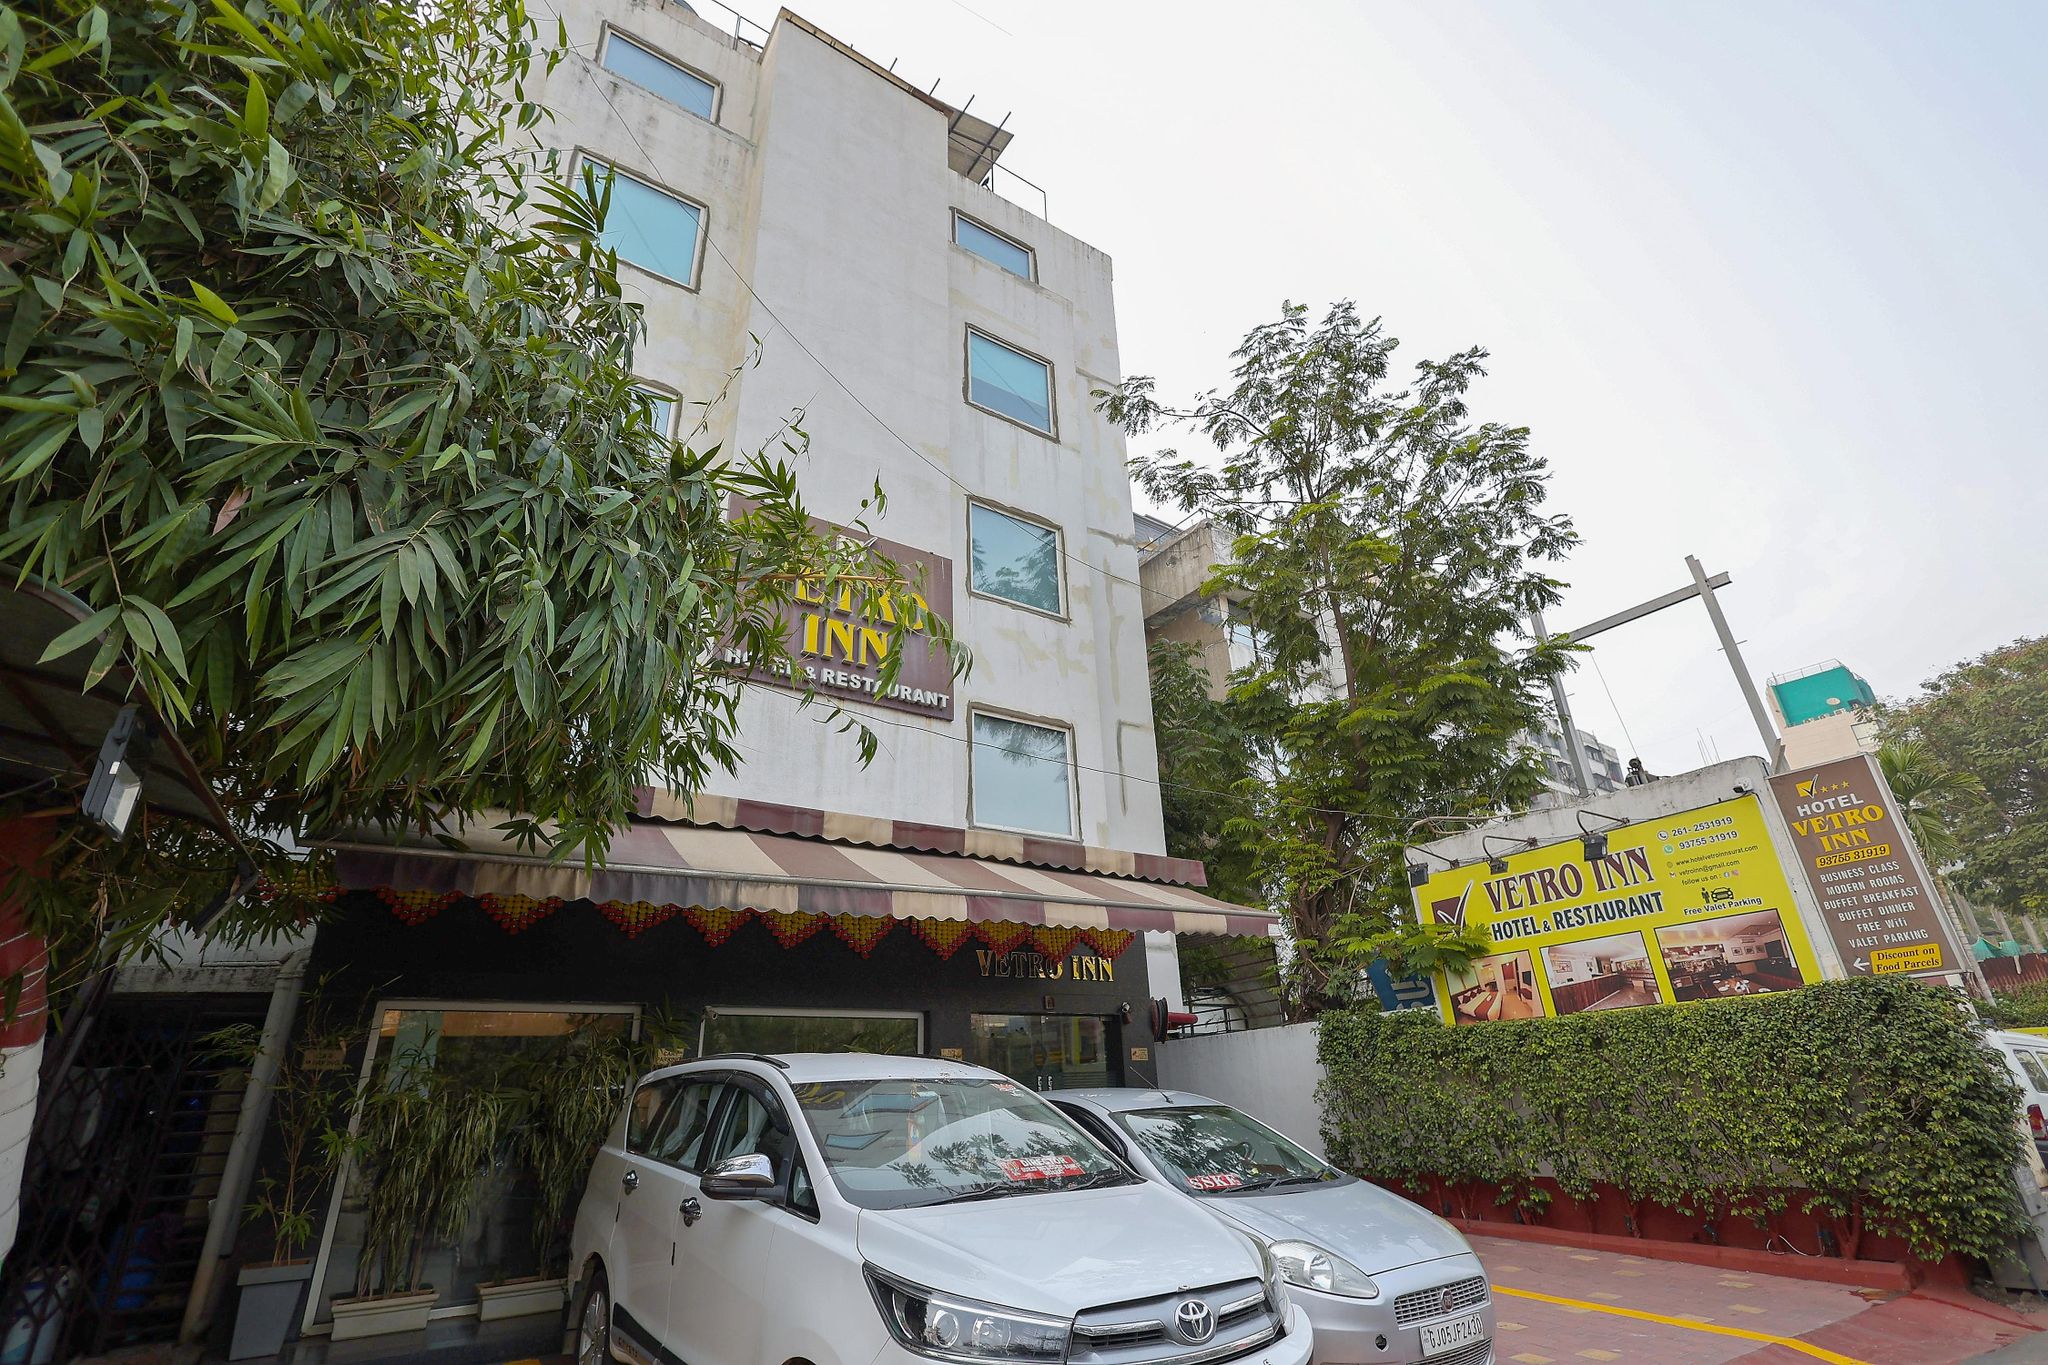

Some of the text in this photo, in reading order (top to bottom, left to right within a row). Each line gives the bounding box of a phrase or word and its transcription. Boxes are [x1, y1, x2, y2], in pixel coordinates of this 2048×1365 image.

[802, 612, 892, 672] INN
[805, 665, 817, 681] &
[1796, 793, 1864, 817] HOTEL
[1693, 816, 1733, 832] 2531919
[1792, 804, 1885, 837] VETRO
[1679, 830, 1738, 850] 93755 31919
[1820, 828, 1872, 853] INN
[1676, 845, 1759, 867] www.hotelvetroinnsurat.com
[1820, 845, 1887, 867] 93755 31919
[1679, 860, 1740, 876] vetroinn@gmail.com
[1820, 861, 1900, 883] BUSINESS CLASS
[1483, 847, 1655, 913] VETRO INN
[1826, 874, 1905, 896] MODERN ROOMS
[1684, 897, 1762, 916] Free Valet Parking
[1823, 886, 1919, 910] BUFFET BREAKFAST
[1491, 891, 1663, 941] HOTEL & RESTAURANT
[1838, 901, 1916, 922] BUFFET DINNER
[1856, 917, 1908, 933] FREE Wifi
[1849, 929, 1929, 949] VALET PARKING
[1876, 957, 1940, 973] Food Parcels
[1877, 947, 1935, 961] Discount on
[976, 949, 1115, 982] VETRO INN
